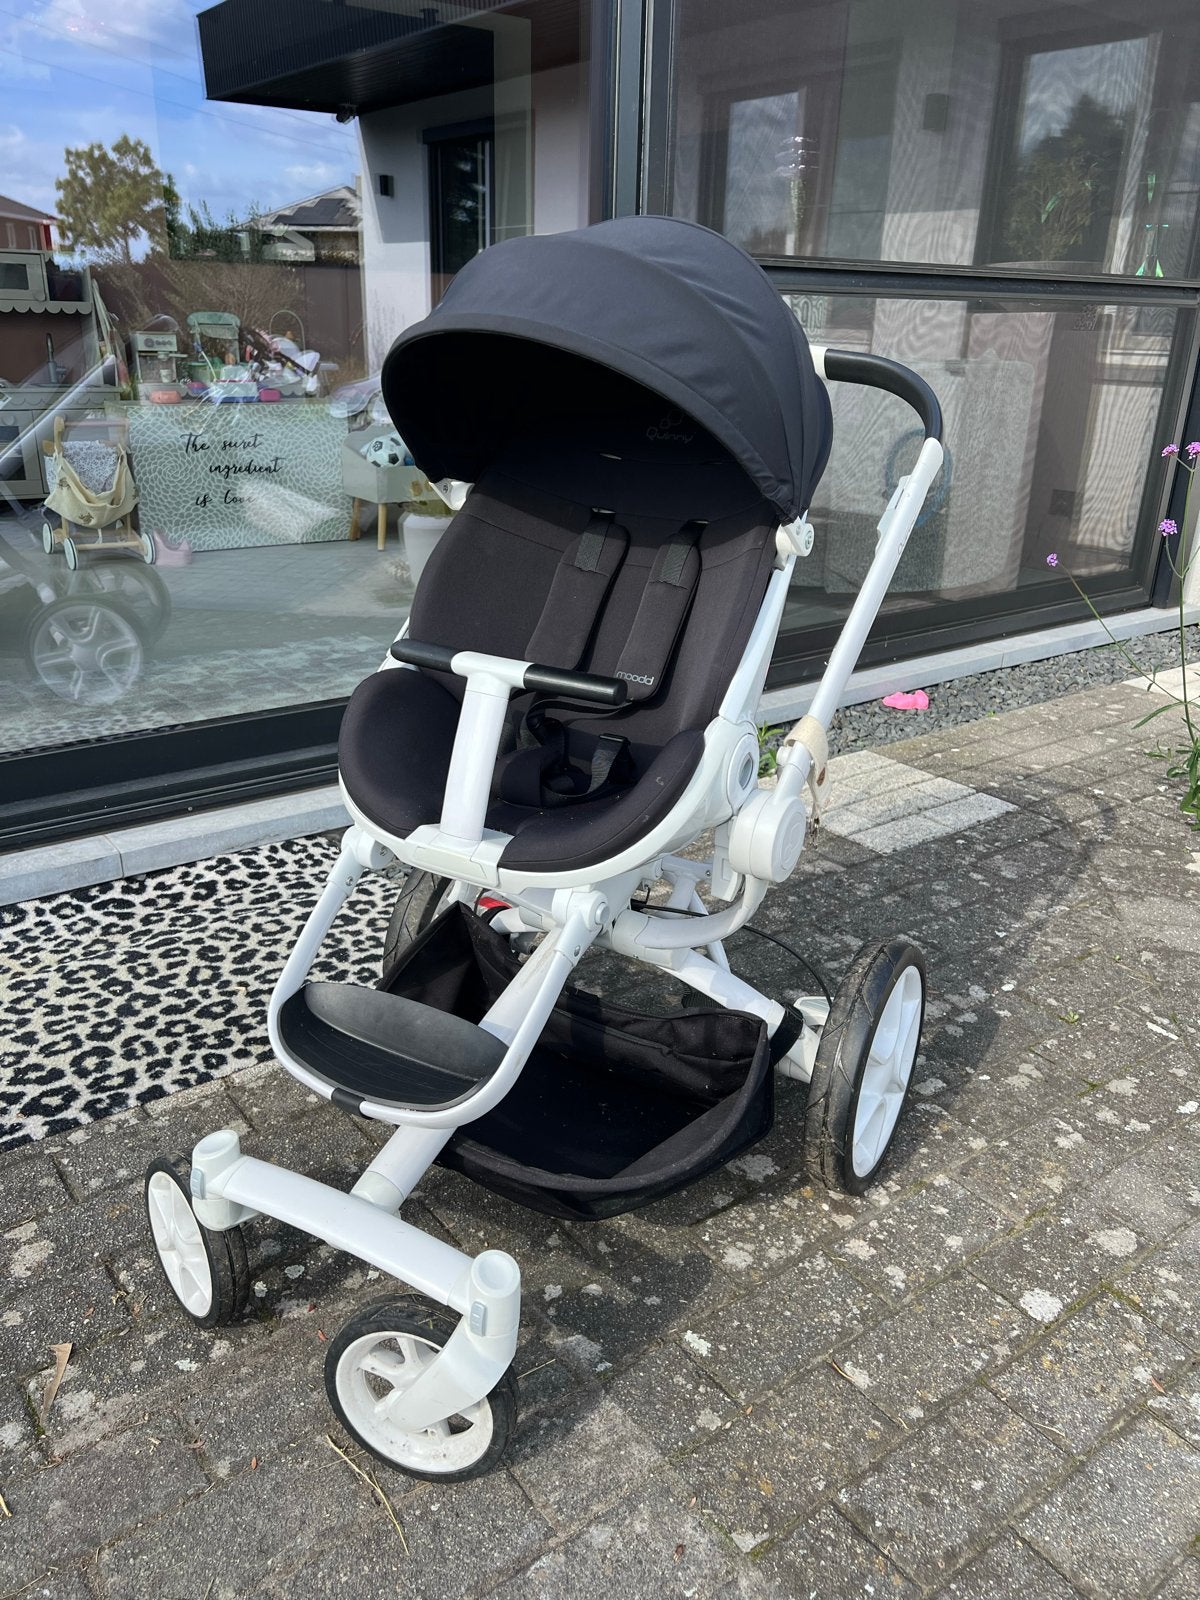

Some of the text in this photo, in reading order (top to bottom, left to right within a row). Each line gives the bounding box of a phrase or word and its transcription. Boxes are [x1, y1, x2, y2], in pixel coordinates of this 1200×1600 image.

[180, 432, 264, 454] The secret
[209, 457, 286, 479] ingredient
[195, 493, 212, 507] is
[616, 671, 655, 686] moodd
